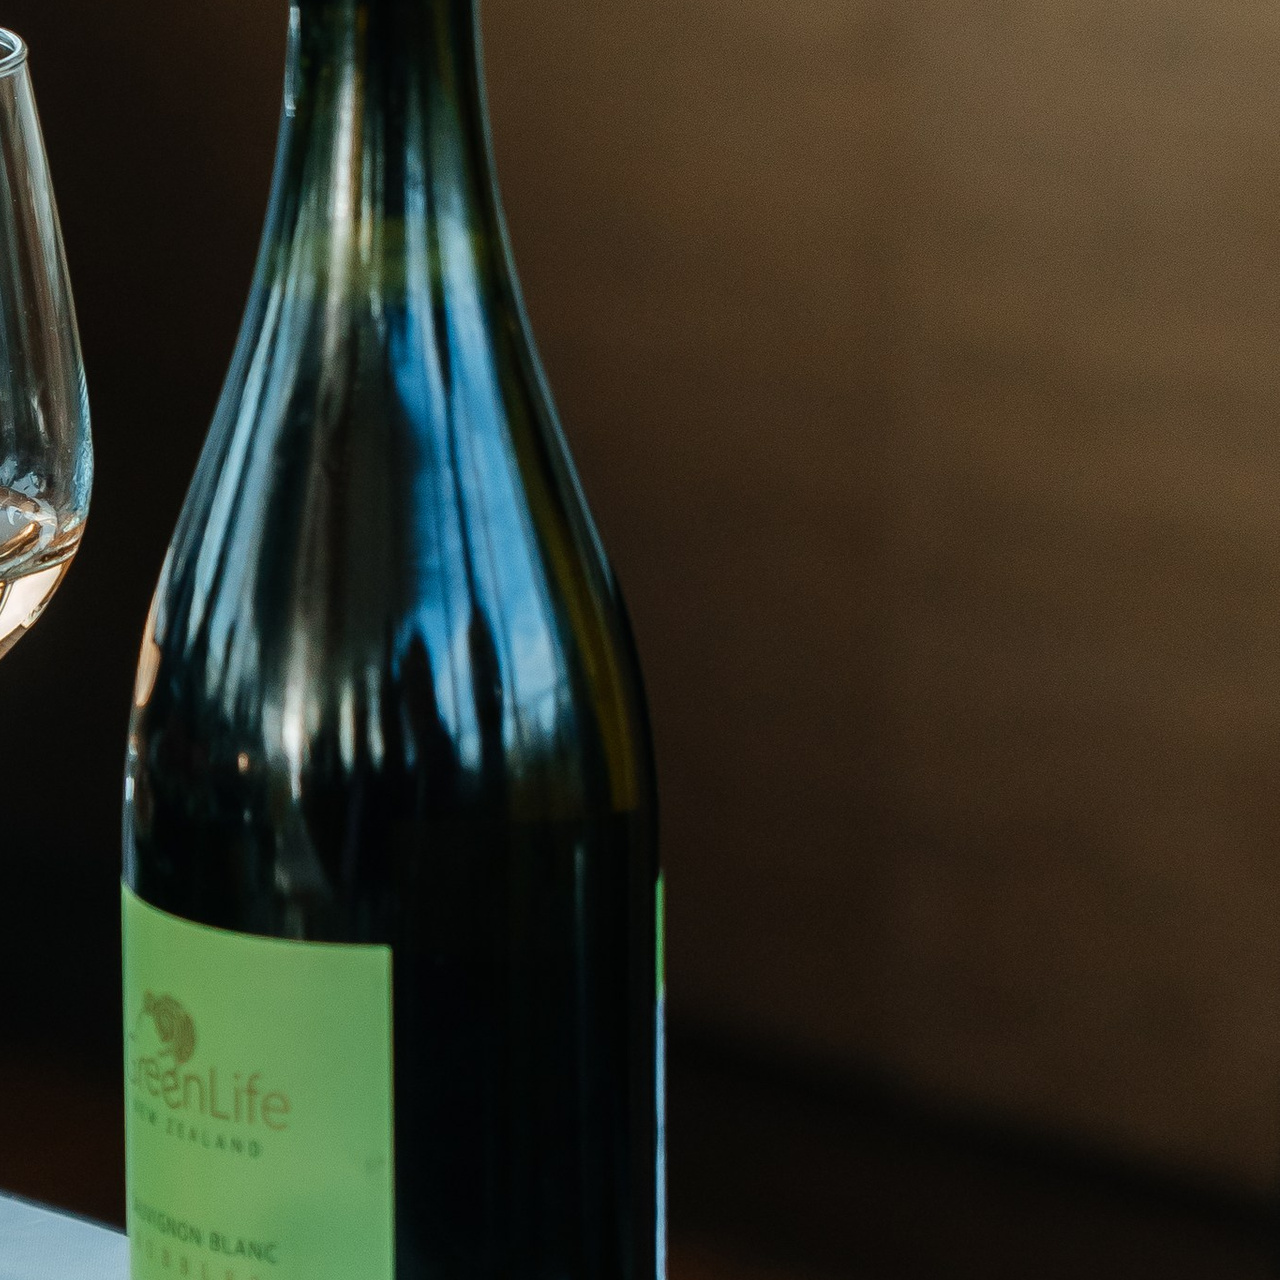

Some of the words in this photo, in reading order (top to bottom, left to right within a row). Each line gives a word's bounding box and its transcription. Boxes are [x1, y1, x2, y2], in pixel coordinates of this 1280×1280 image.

[131, 1053, 292, 1131] reenLife
[165, 1117, 264, 1159] ZEALAND
[208, 1229, 280, 1265] BLANC
